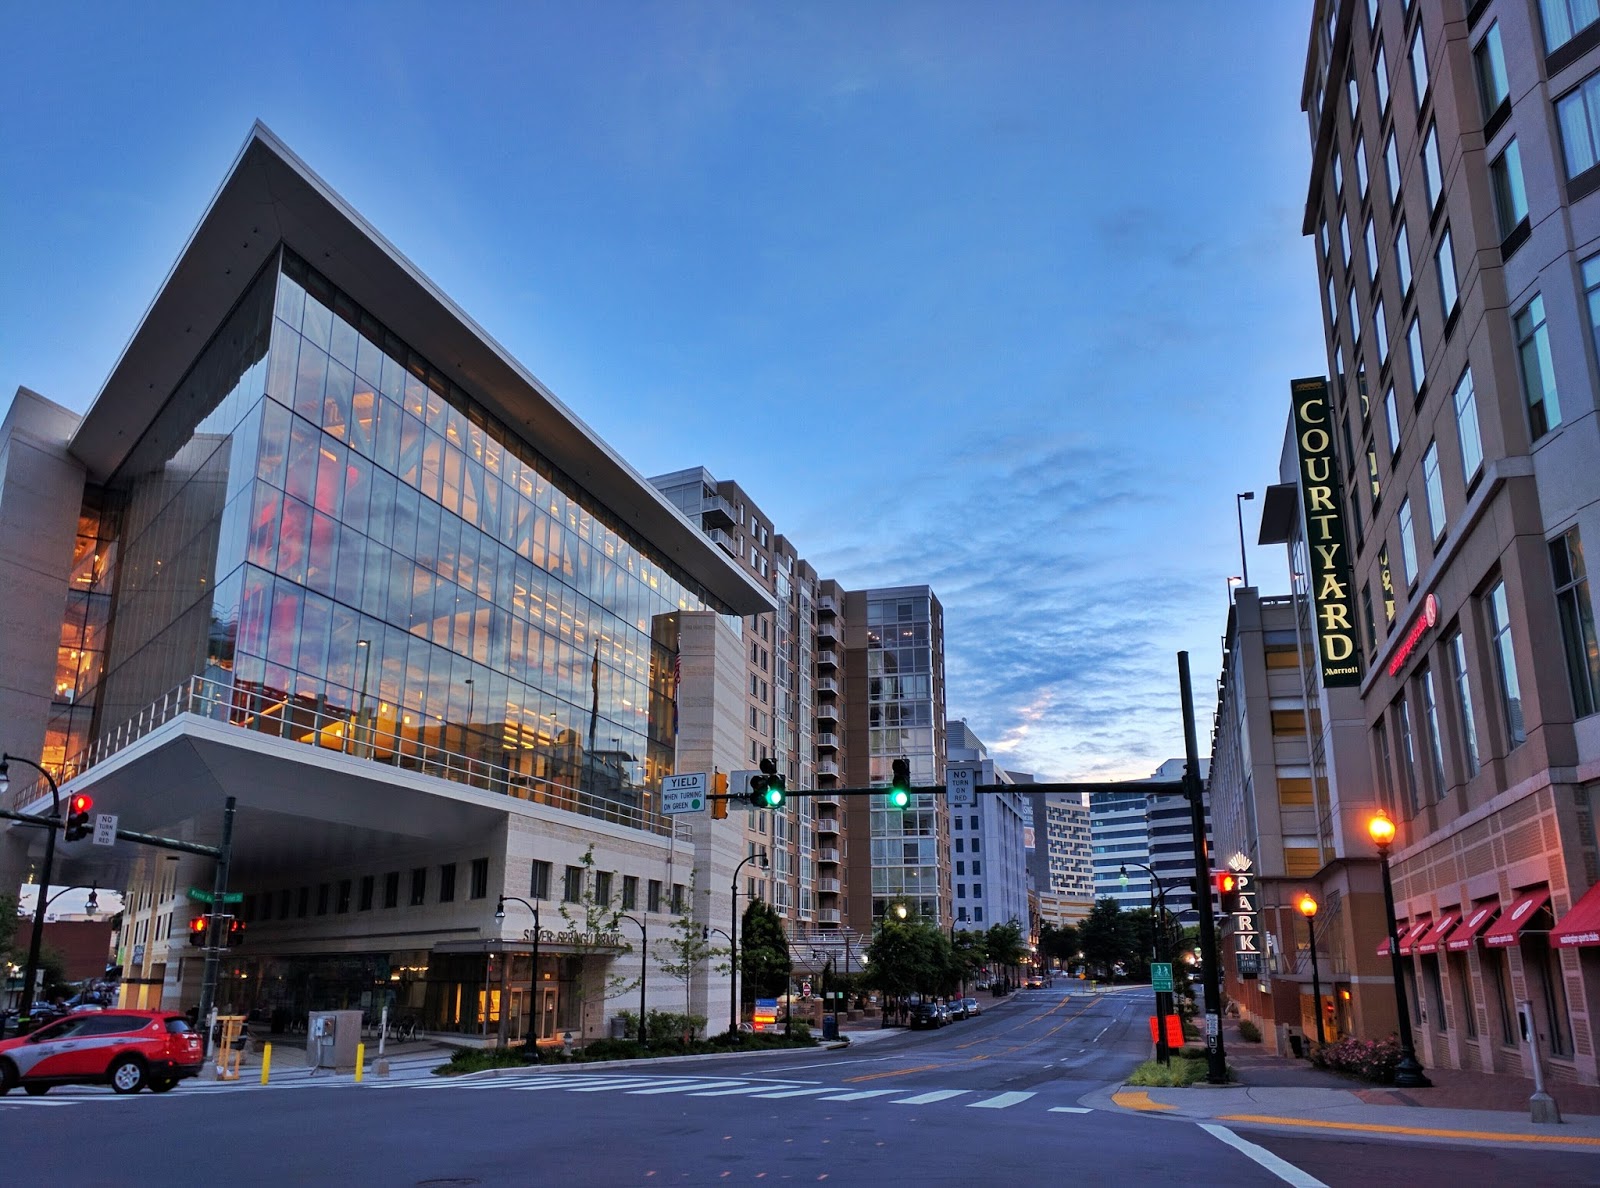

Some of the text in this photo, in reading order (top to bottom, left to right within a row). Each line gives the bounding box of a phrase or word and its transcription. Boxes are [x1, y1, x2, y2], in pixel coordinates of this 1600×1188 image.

[1300, 398, 1353, 661] COURTYARD
[1325, 666, 1358, 676] Marriott
[671, 777, 698, 787] YIELD
[680, 790, 703, 799] TURNING
[1238, 876, 1256, 951] PARK
